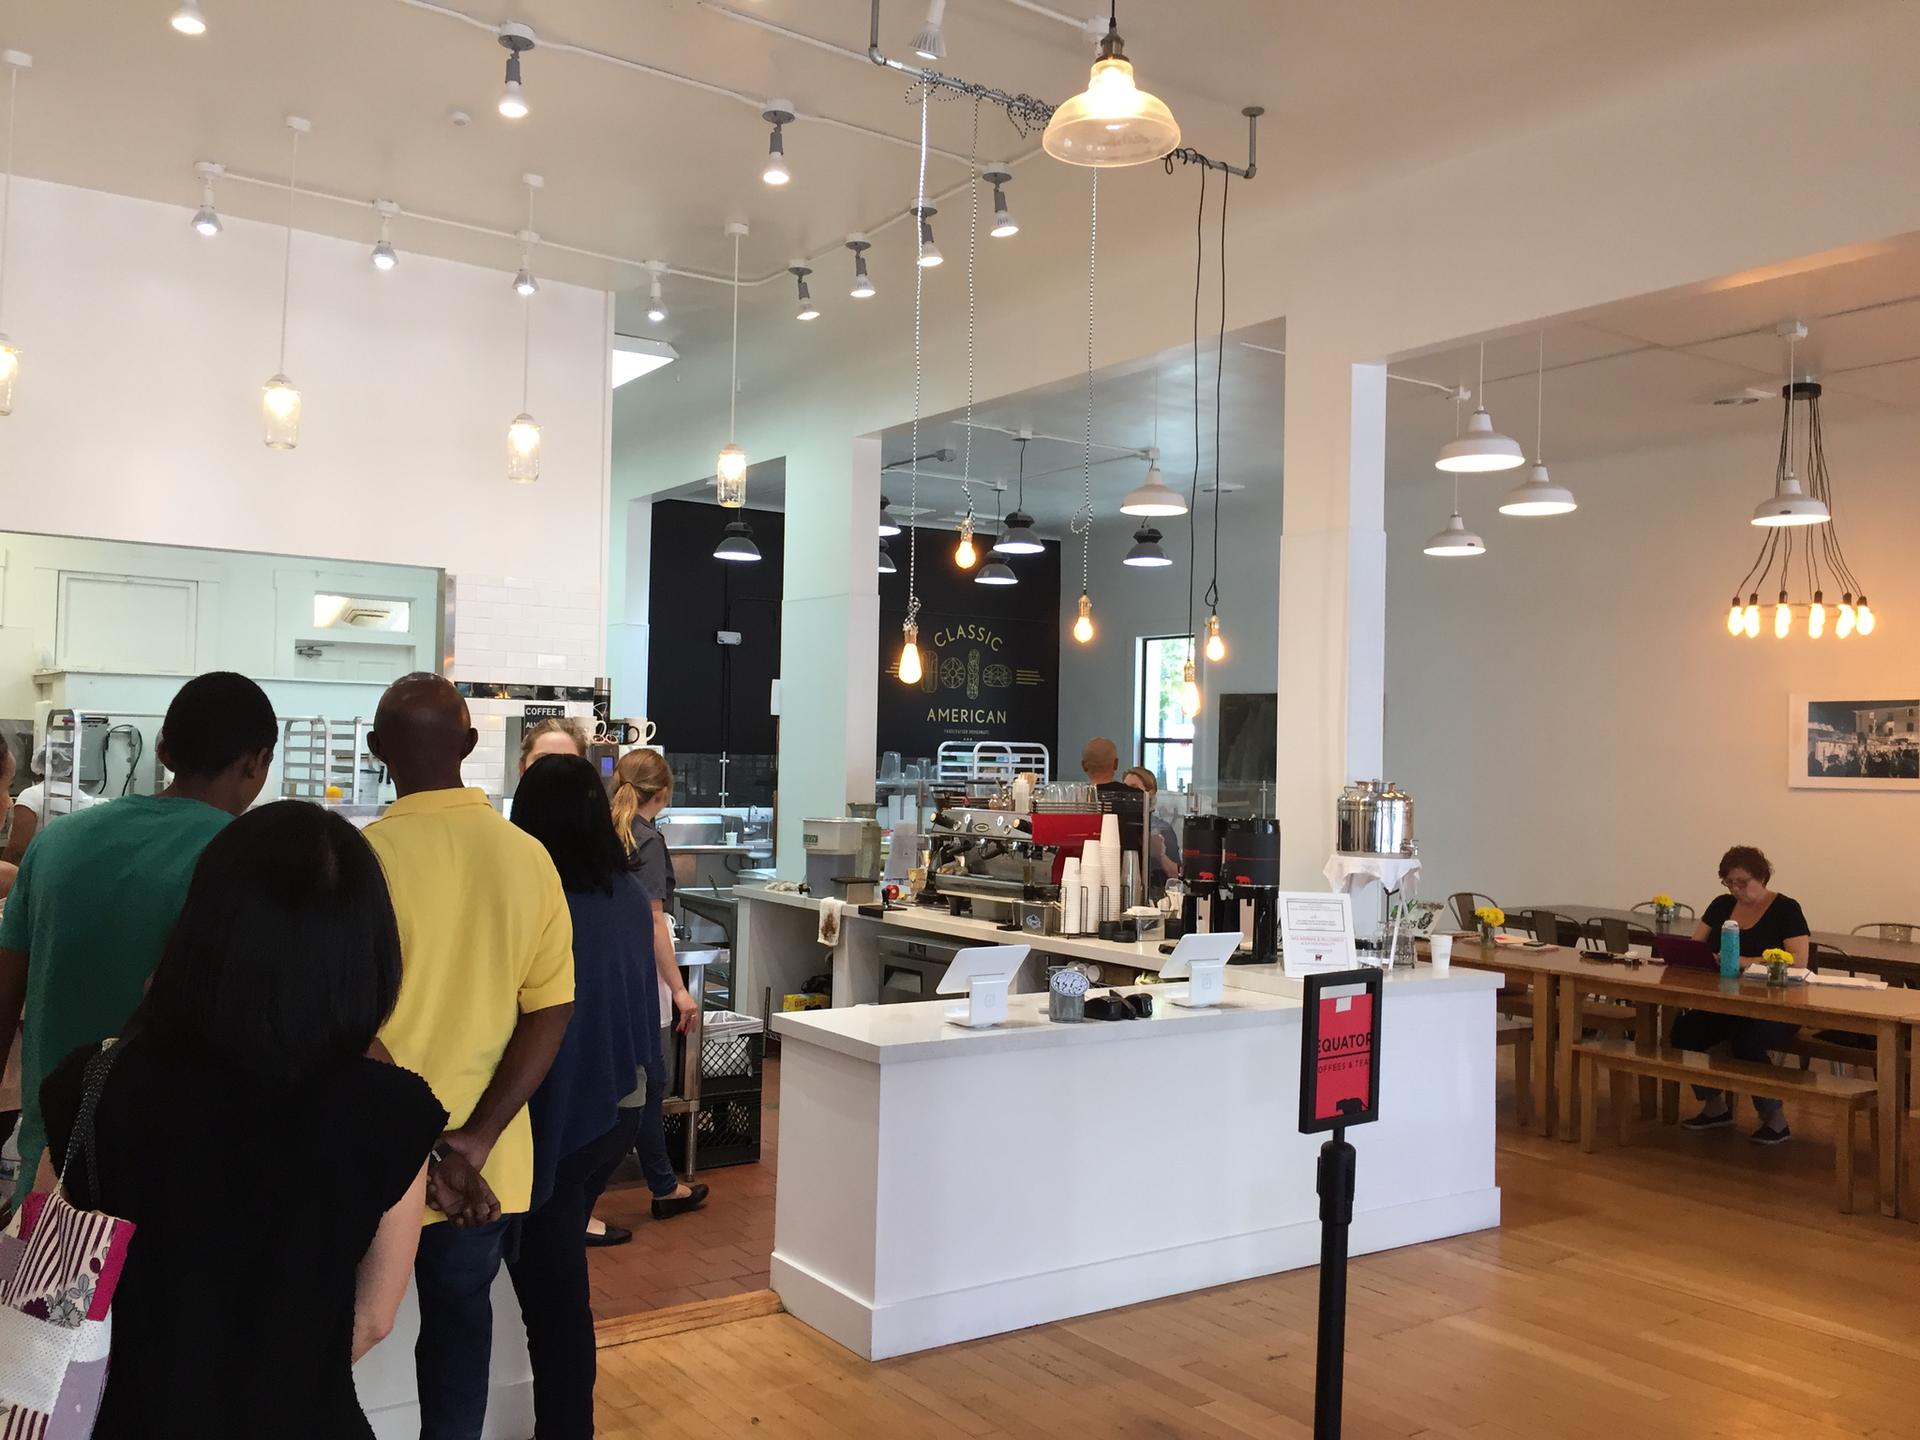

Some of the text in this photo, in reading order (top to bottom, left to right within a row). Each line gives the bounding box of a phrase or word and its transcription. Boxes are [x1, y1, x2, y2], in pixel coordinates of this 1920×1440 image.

[934, 624, 1003, 652] CLASSIC
[525, 707, 557, 716] COFFEE
[926, 707, 1007, 724] AMERICAN
[1319, 1061, 1345, 1074] OFFEES
